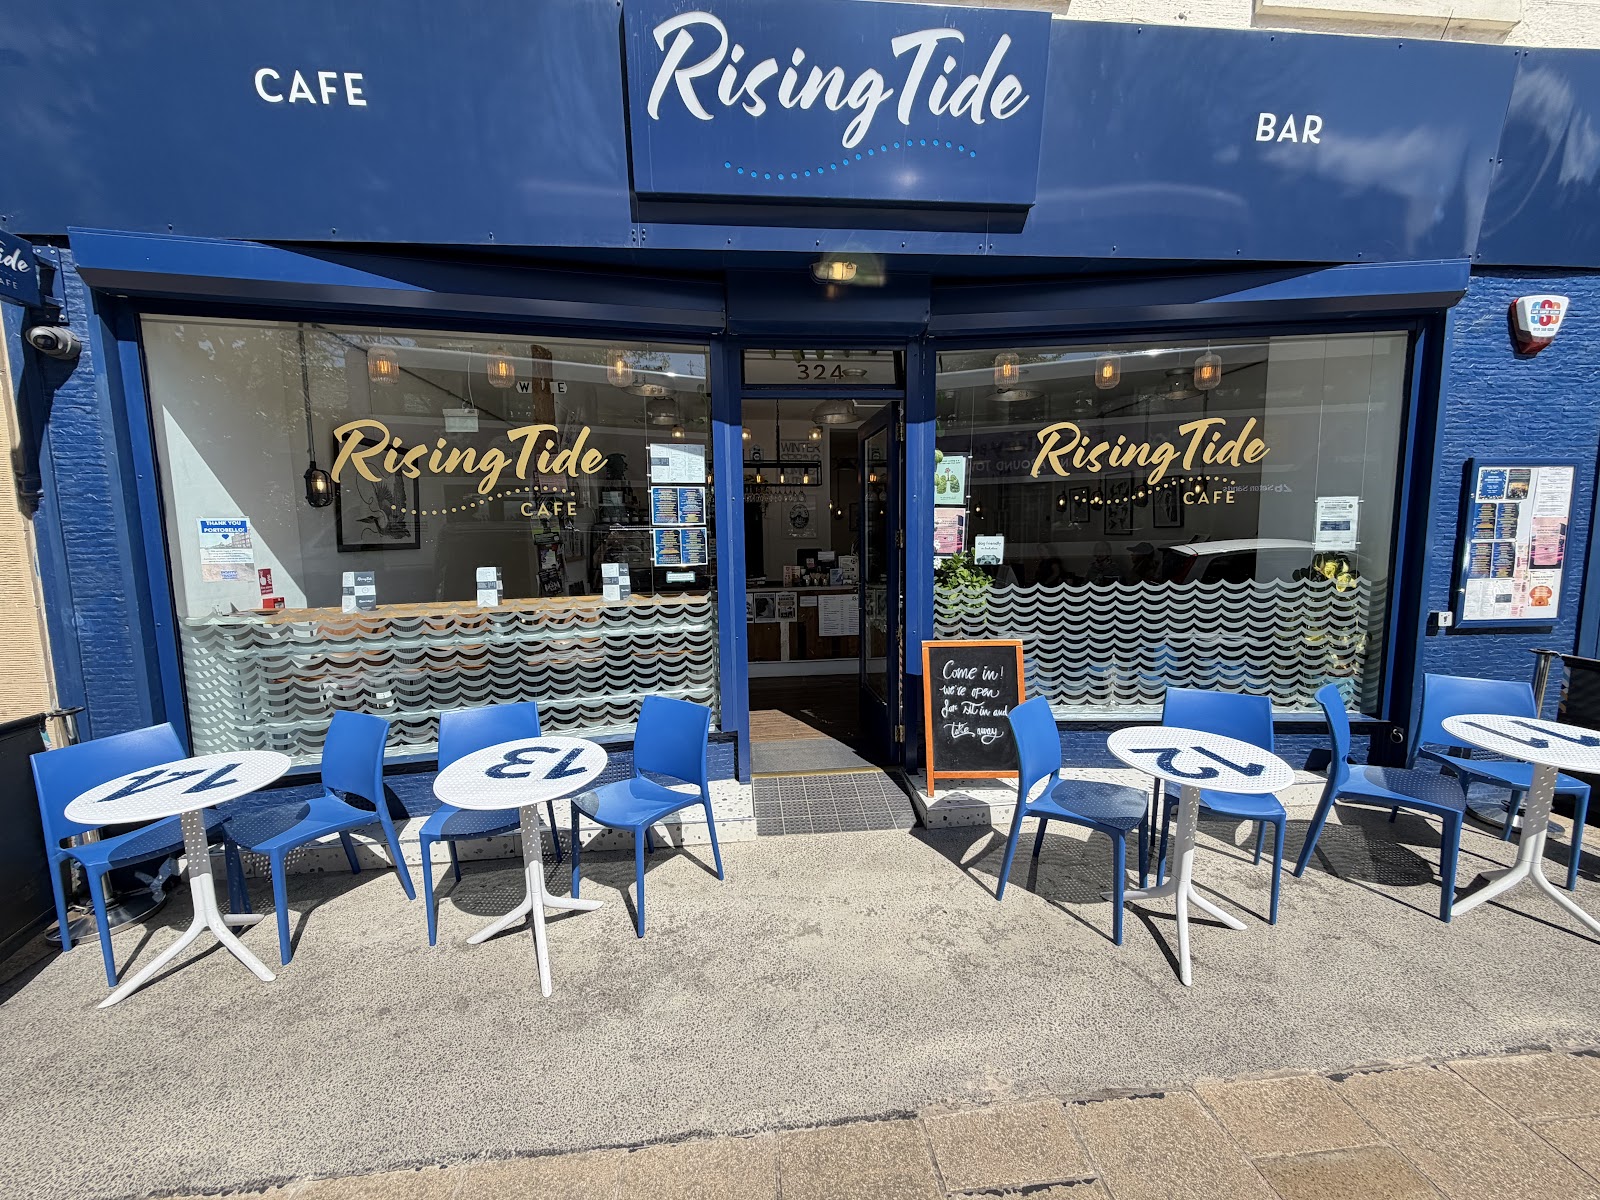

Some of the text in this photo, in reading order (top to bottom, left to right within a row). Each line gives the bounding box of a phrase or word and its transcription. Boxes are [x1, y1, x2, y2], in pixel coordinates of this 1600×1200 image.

[254, 67, 367, 106] CAFE
[647, 11, 1030, 149] Rising Tide
[1255, 112, 1323, 144] BAR
[0, 240, 31, 273] ide
[797, 364, 844, 380] 324
[519, 382, 530, 393] W
[558, 382, 565, 393] E
[331, 419, 513, 495] Rising
[507, 424, 609, 480] Tide
[1030, 417, 1271, 486] Rising Tide
[521, 502, 577, 516] CAFE
[1183, 491, 1236, 505] CAFE
[943, 660, 1004, 681] Come in!
[971, 687, 1000, 699] open
[941, 699, 958, 718] for
[979, 705, 991, 716] in
[993, 705, 1008, 717] and
[943, 722, 1004, 745] take away
[486, 746, 588, 780] 13
[1128, 745, 1265, 779] 12
[97, 762, 243, 803] 14
